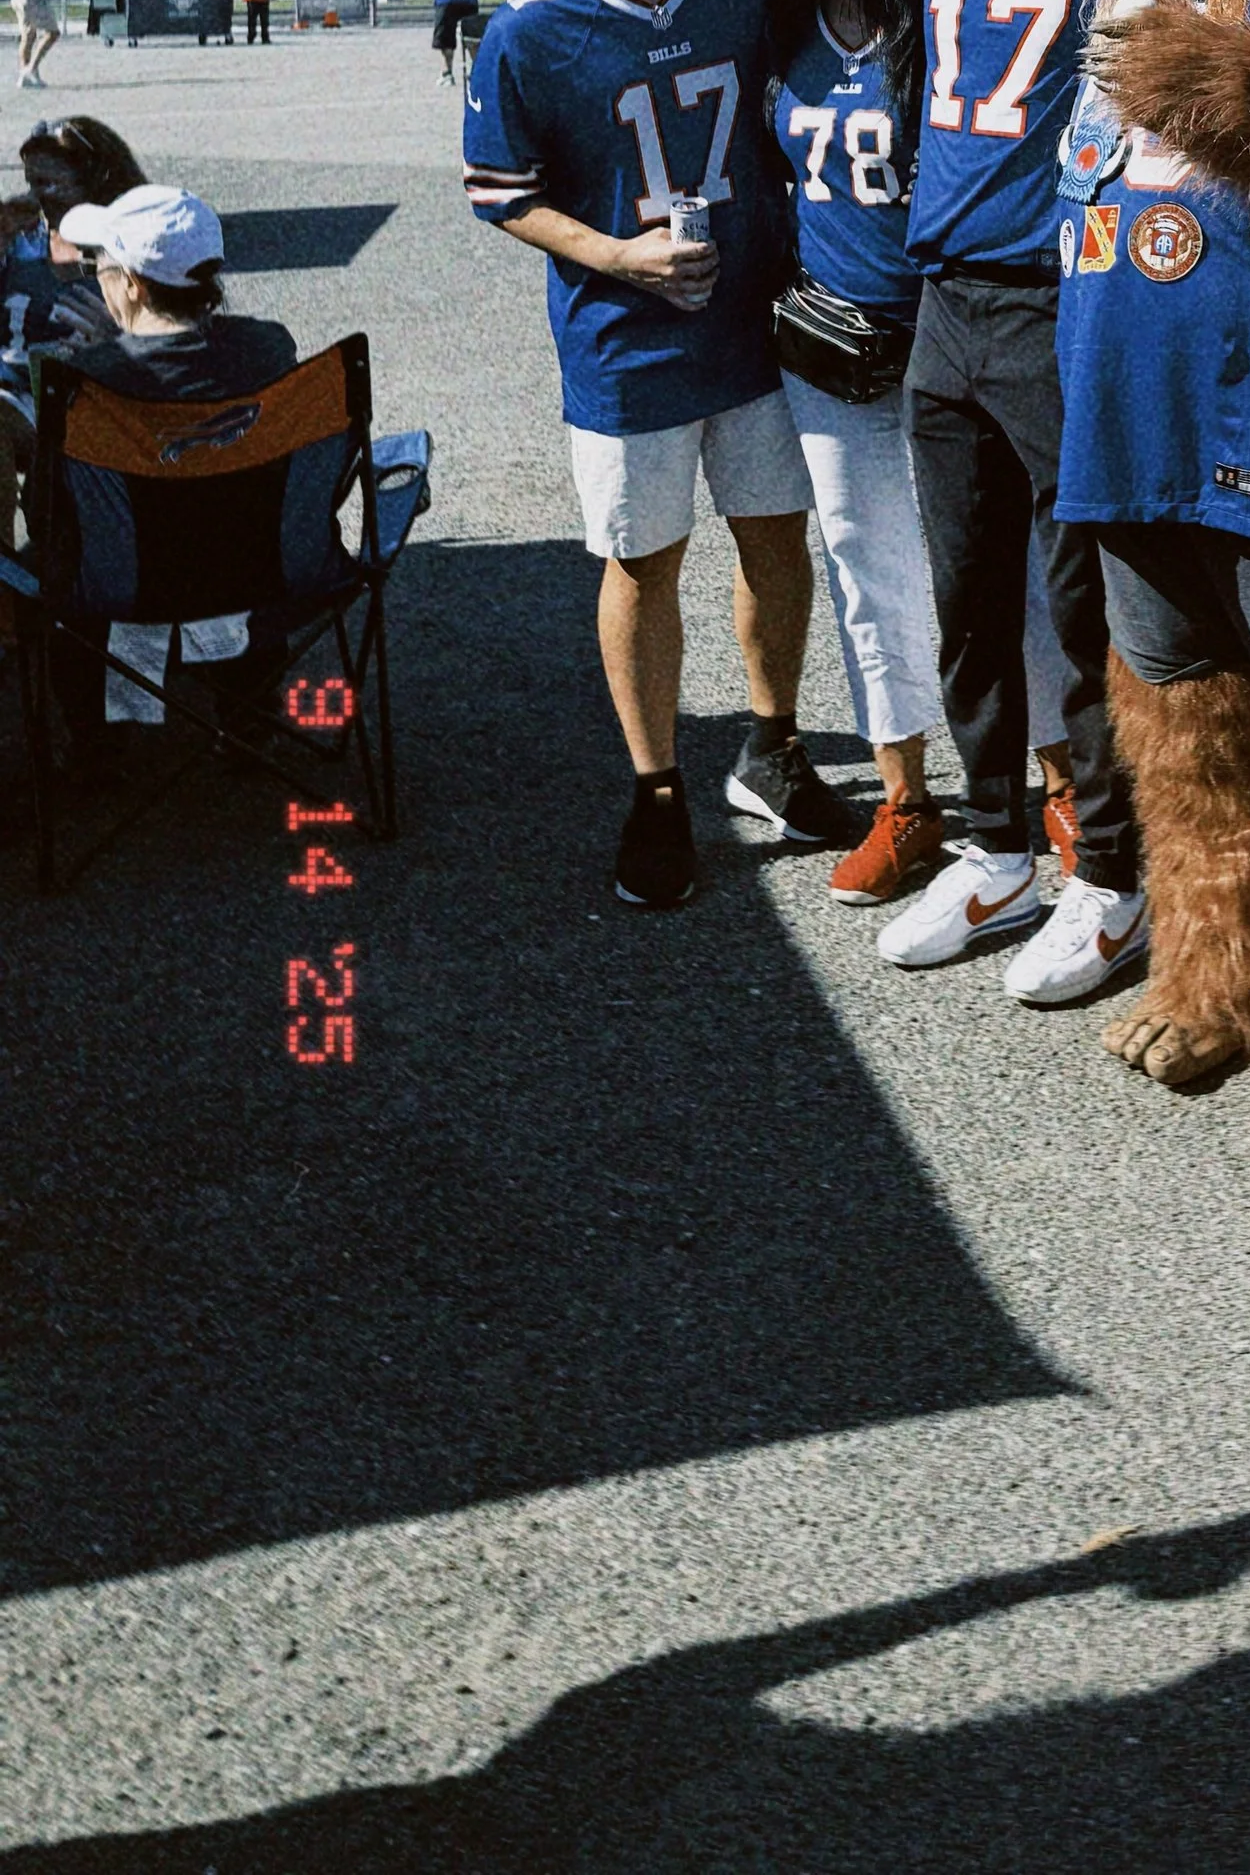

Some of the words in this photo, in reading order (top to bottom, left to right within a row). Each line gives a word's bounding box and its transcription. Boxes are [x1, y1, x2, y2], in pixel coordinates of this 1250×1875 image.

[647, 41, 692, 64] BILLS
[614, 56, 742, 226] 17
[788, 106, 901, 207] 78
[1156, 234, 1173, 253] AA
